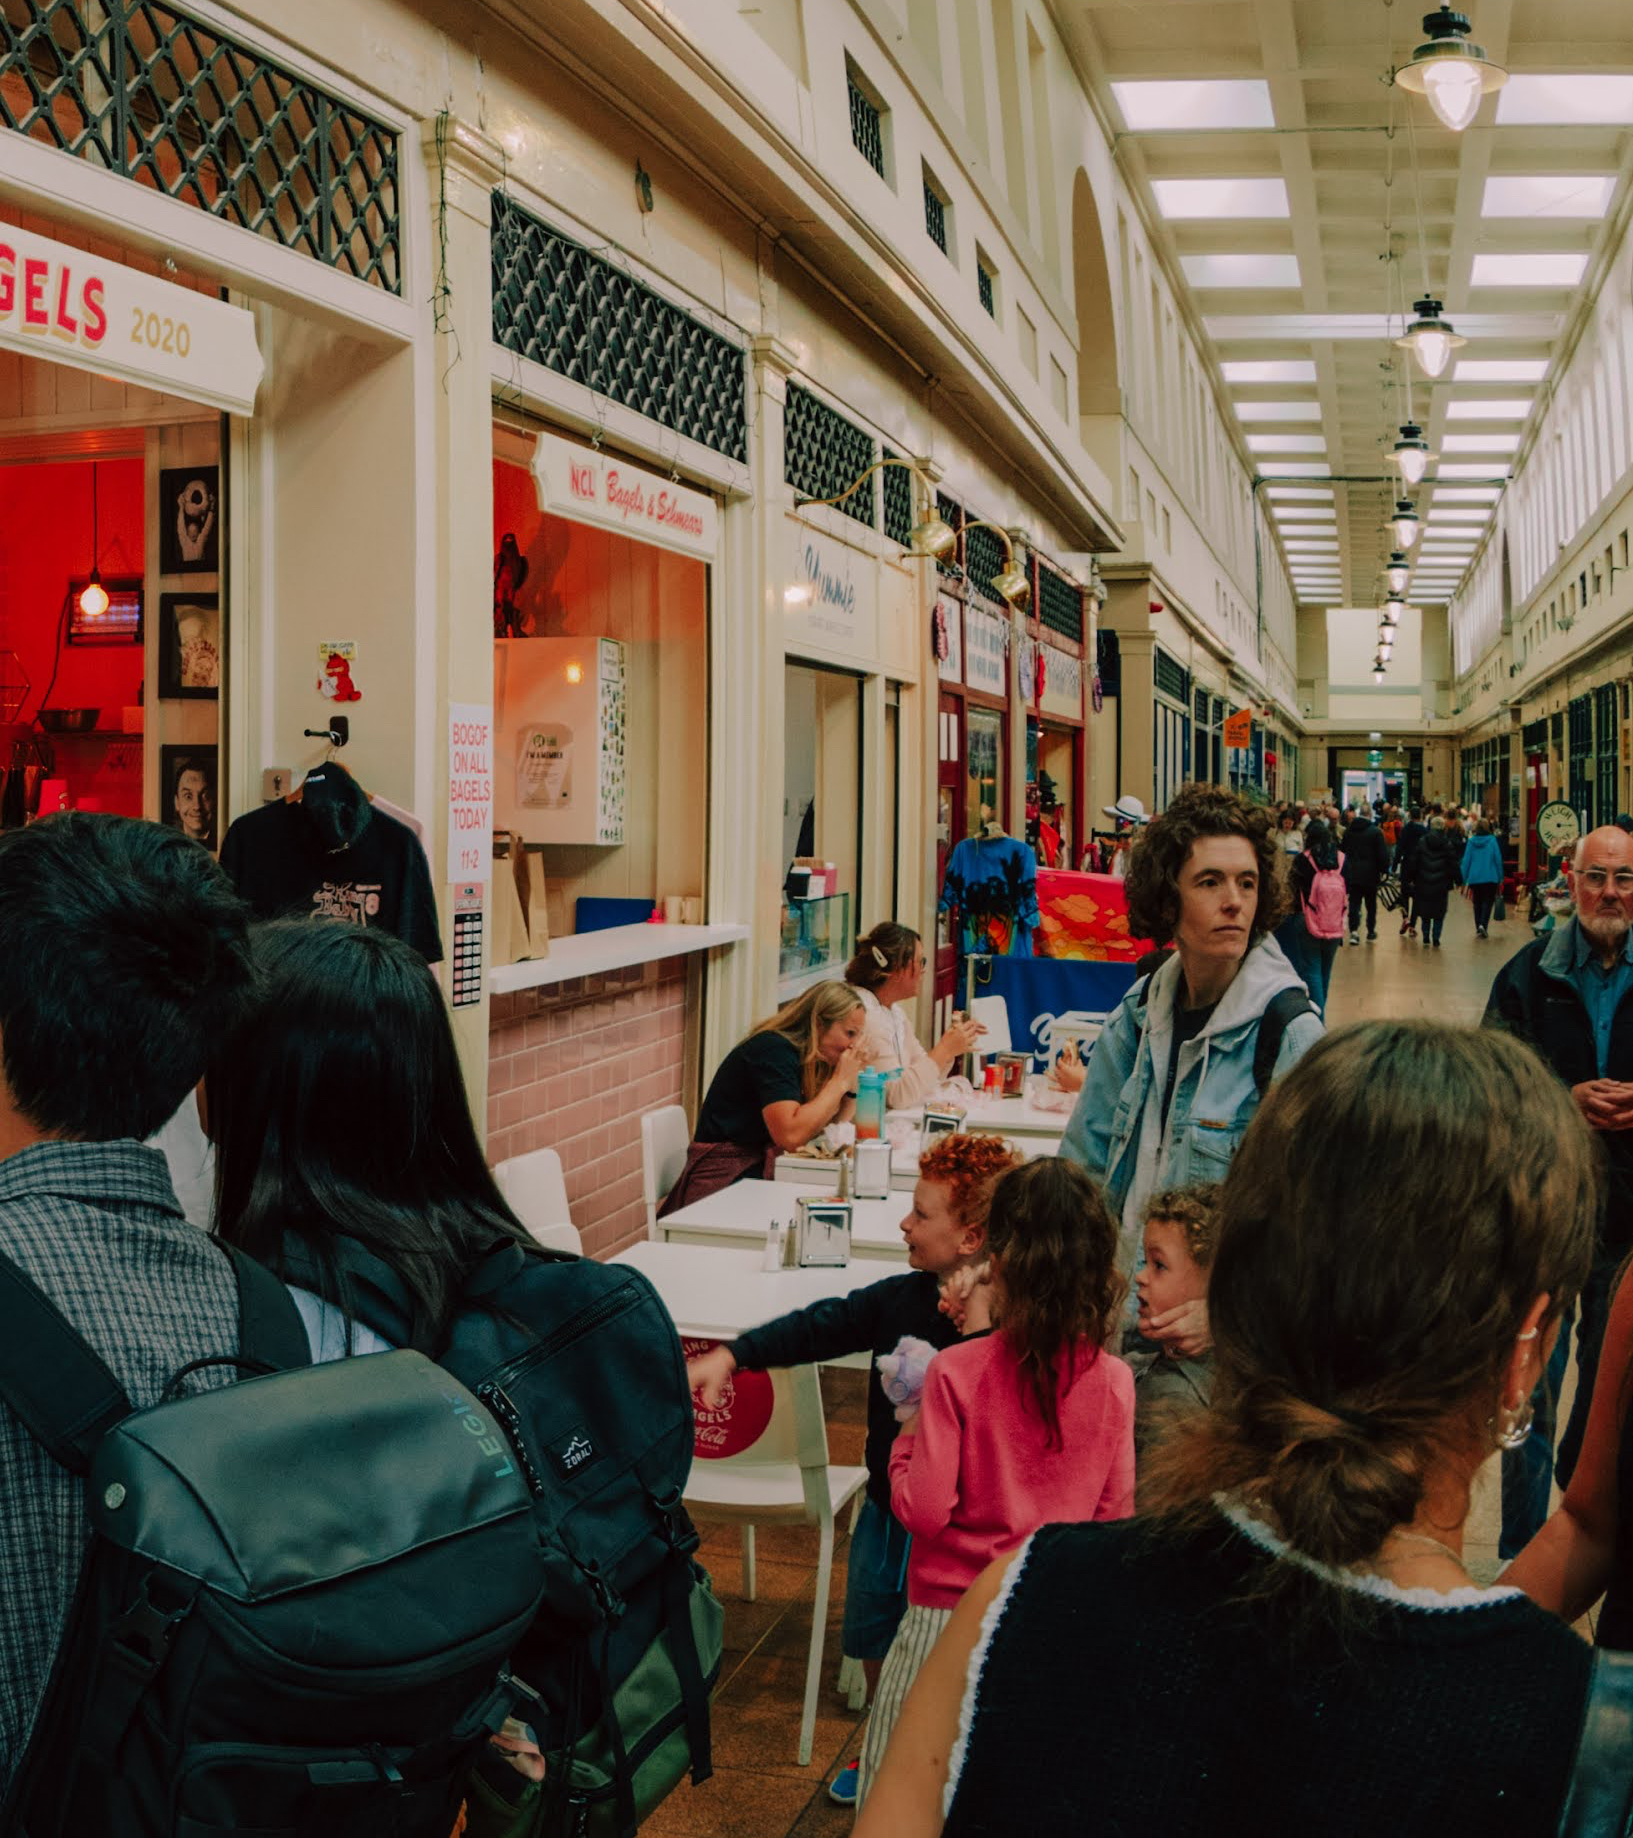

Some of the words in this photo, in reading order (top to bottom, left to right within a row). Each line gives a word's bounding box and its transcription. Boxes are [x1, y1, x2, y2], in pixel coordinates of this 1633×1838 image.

[130, 307, 191, 358] 2020
[571, 465, 595, 498] NCL
[607, 470, 645, 518] Bagels
[453, 722, 488, 746] BOGOF
[454, 752, 468, 773] ON
[469, 753, 488, 774] ALL
[450, 779, 490, 801] BAGELS
[453, 807, 488, 829] TODAY
[694, 1409, 732, 1423] GELS
